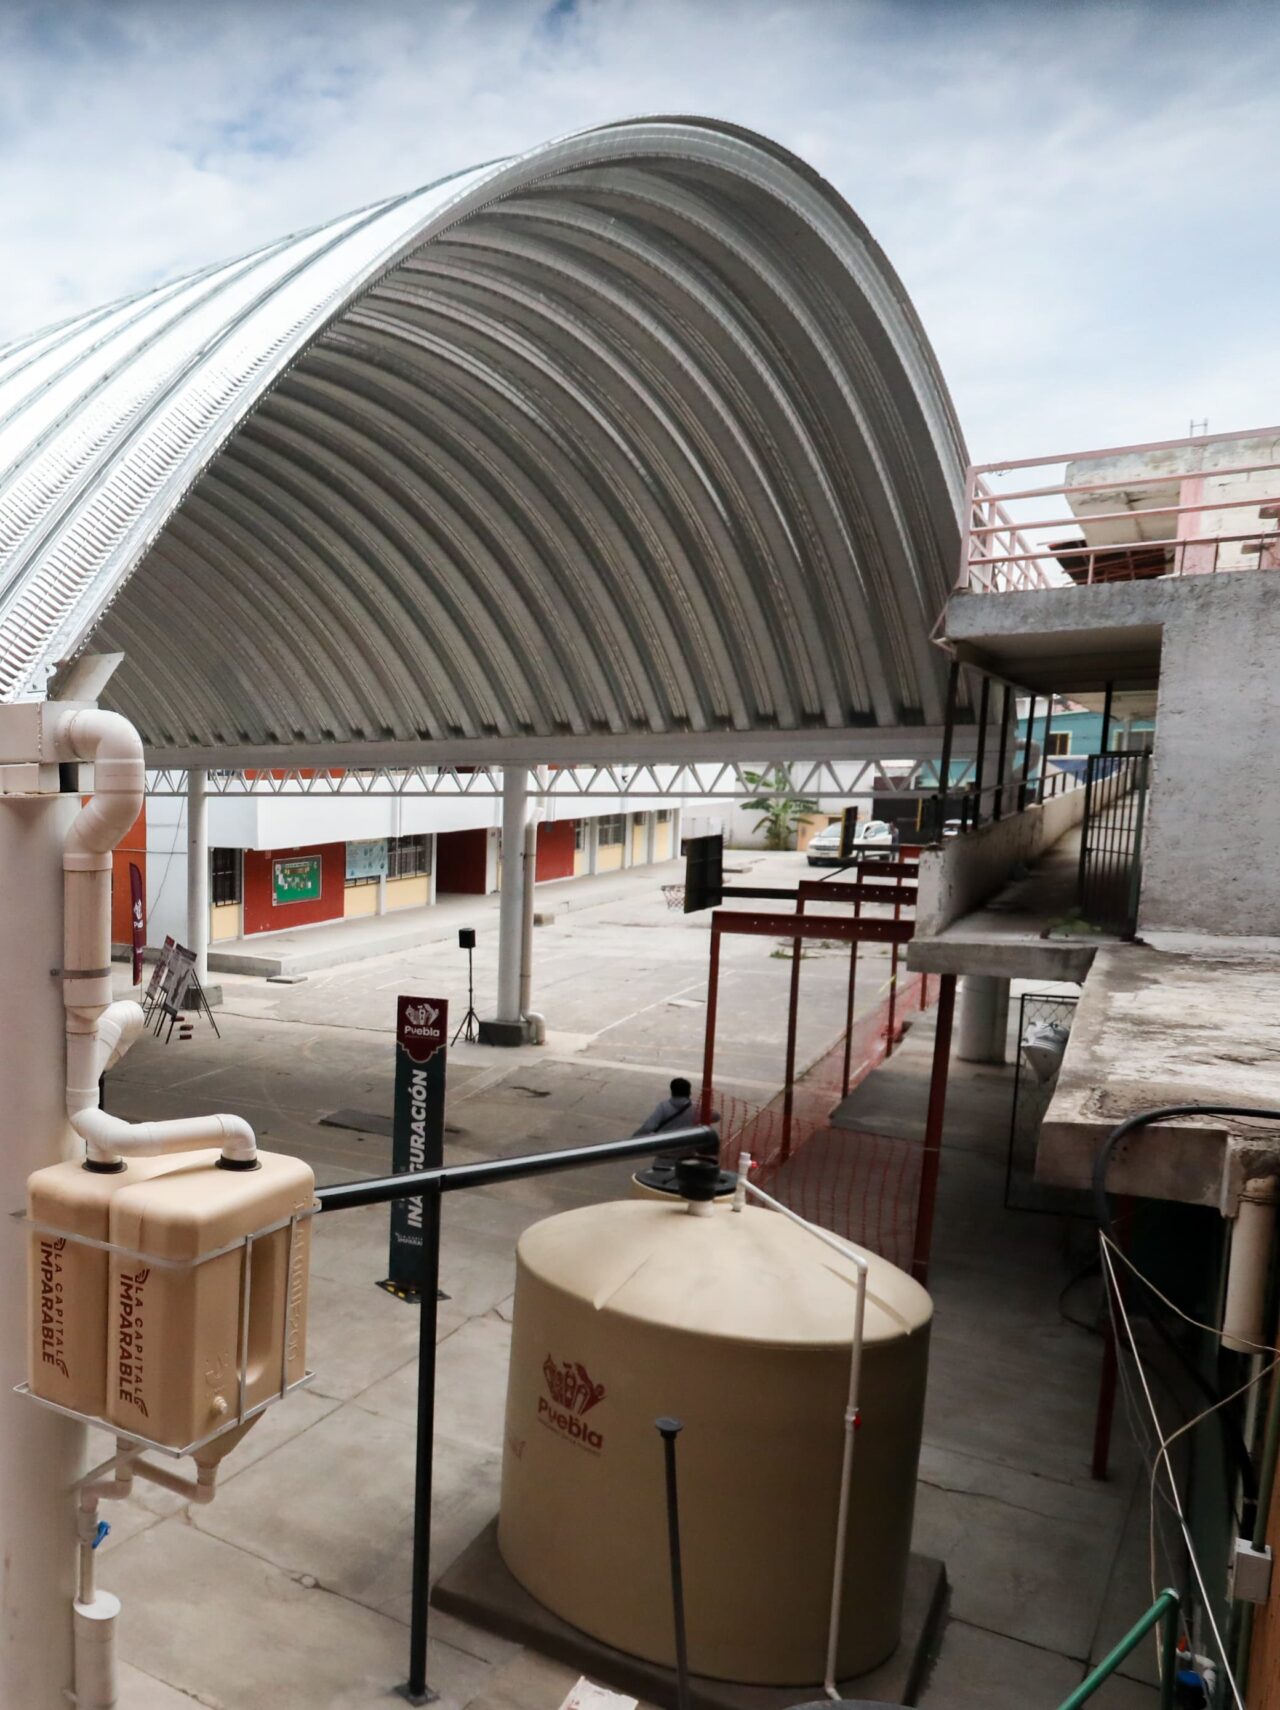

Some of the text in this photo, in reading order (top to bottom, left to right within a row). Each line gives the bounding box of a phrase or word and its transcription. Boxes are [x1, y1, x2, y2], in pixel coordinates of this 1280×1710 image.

[404, 1025, 440, 1037] Puebla
[41, 1241, 54, 1366] IMPARABLE
[54, 1254, 64, 1360] LA CAPITAL
[120, 1273, 133, 1403] IMPARABLE
[134, 1287, 144, 1397] LA CAPITAL
[538, 1396, 603, 1449] Puebla
